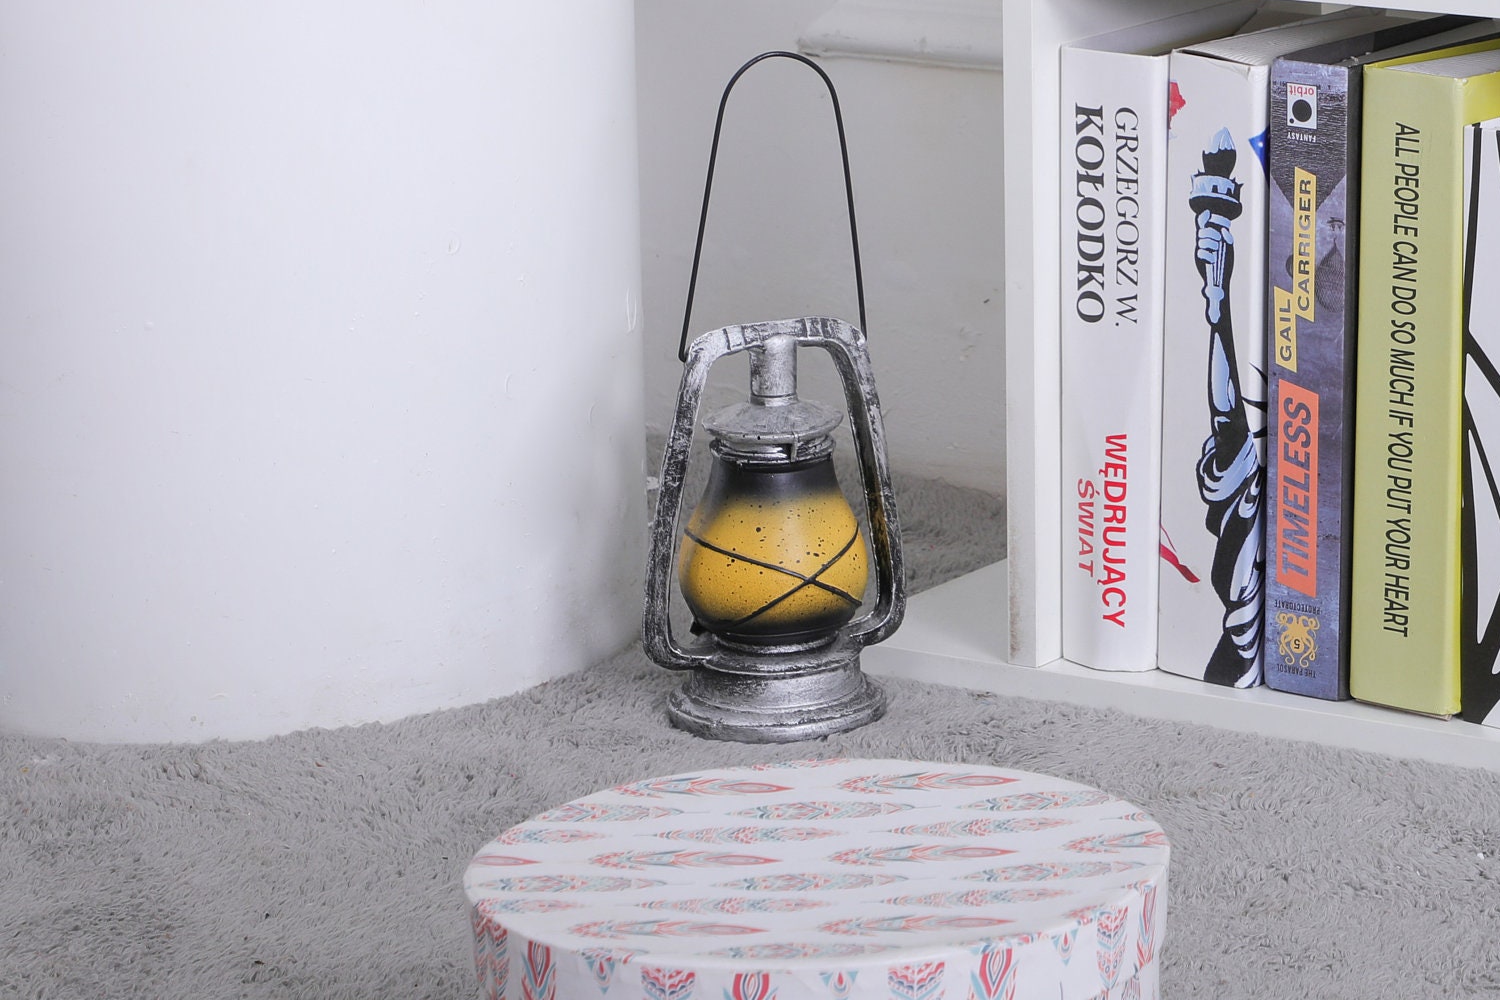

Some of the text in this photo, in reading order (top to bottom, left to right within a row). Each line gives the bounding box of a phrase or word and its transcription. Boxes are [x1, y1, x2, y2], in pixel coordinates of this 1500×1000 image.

[1286, 131, 1317, 143] FANTASY
[1288, 85, 1315, 98] orbit
[1075, 102, 1106, 324] KOŁODKO
[1114, 106, 1140, 327] GRZEGORZ W.
[1279, 178, 1312, 362] GAIL CARRIGER
[1383, 121, 1421, 638] ALL PEOPLE CAN DO SO MUCH IF YOU PUT YOUR HEART
[1077, 478, 1101, 578] ŚWIAT
[1096, 433, 1128, 629] WĘDRUJĄCY
[1281, 396, 1312, 578] TIMELESS
[1273, 599, 1321, 615] PROTECTORATE
[1277, 663, 1317, 679] THE PARASOL
[1293, 638, 1301, 650] 5
